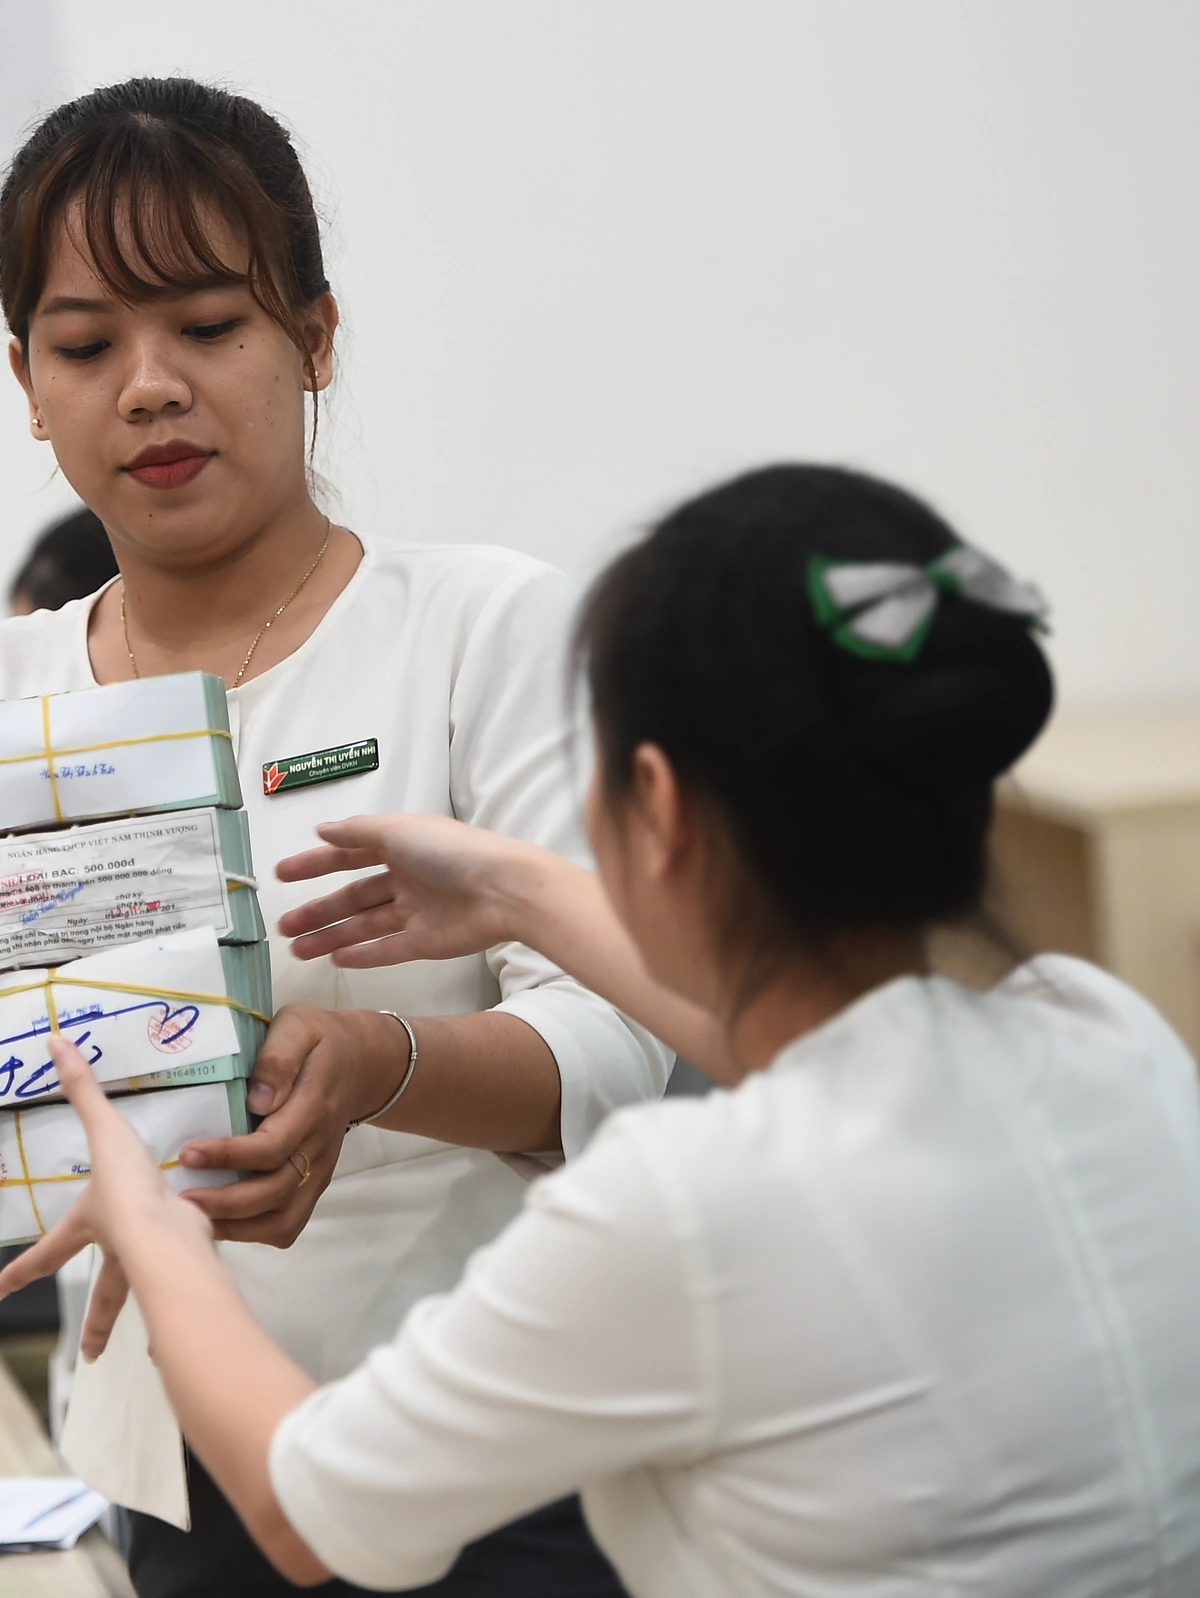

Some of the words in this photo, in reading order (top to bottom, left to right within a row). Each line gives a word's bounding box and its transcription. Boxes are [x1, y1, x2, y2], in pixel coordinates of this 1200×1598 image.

[289, 756, 323, 774] NGUYỄN
[323, 755, 338, 766] THỊ
[361, 745, 376, 757] NHI
[7, 850, 33, 859] NGÂN
[35, 846, 60, 856] HÀNG
[88, 838, 108, 848] VIỆT
[111, 834, 131, 843] NAM
[134, 830, 163, 840] THỊNH
[164, 824, 198, 835] VƯỢNG
[84, 858, 135, 874] 500.000đ
[97, 870, 148, 884] 500.000.000
[115, 921, 134, 932] Ngân
[135, 918, 155, 929] hàng
[24, 938, 43, 949] nhận
